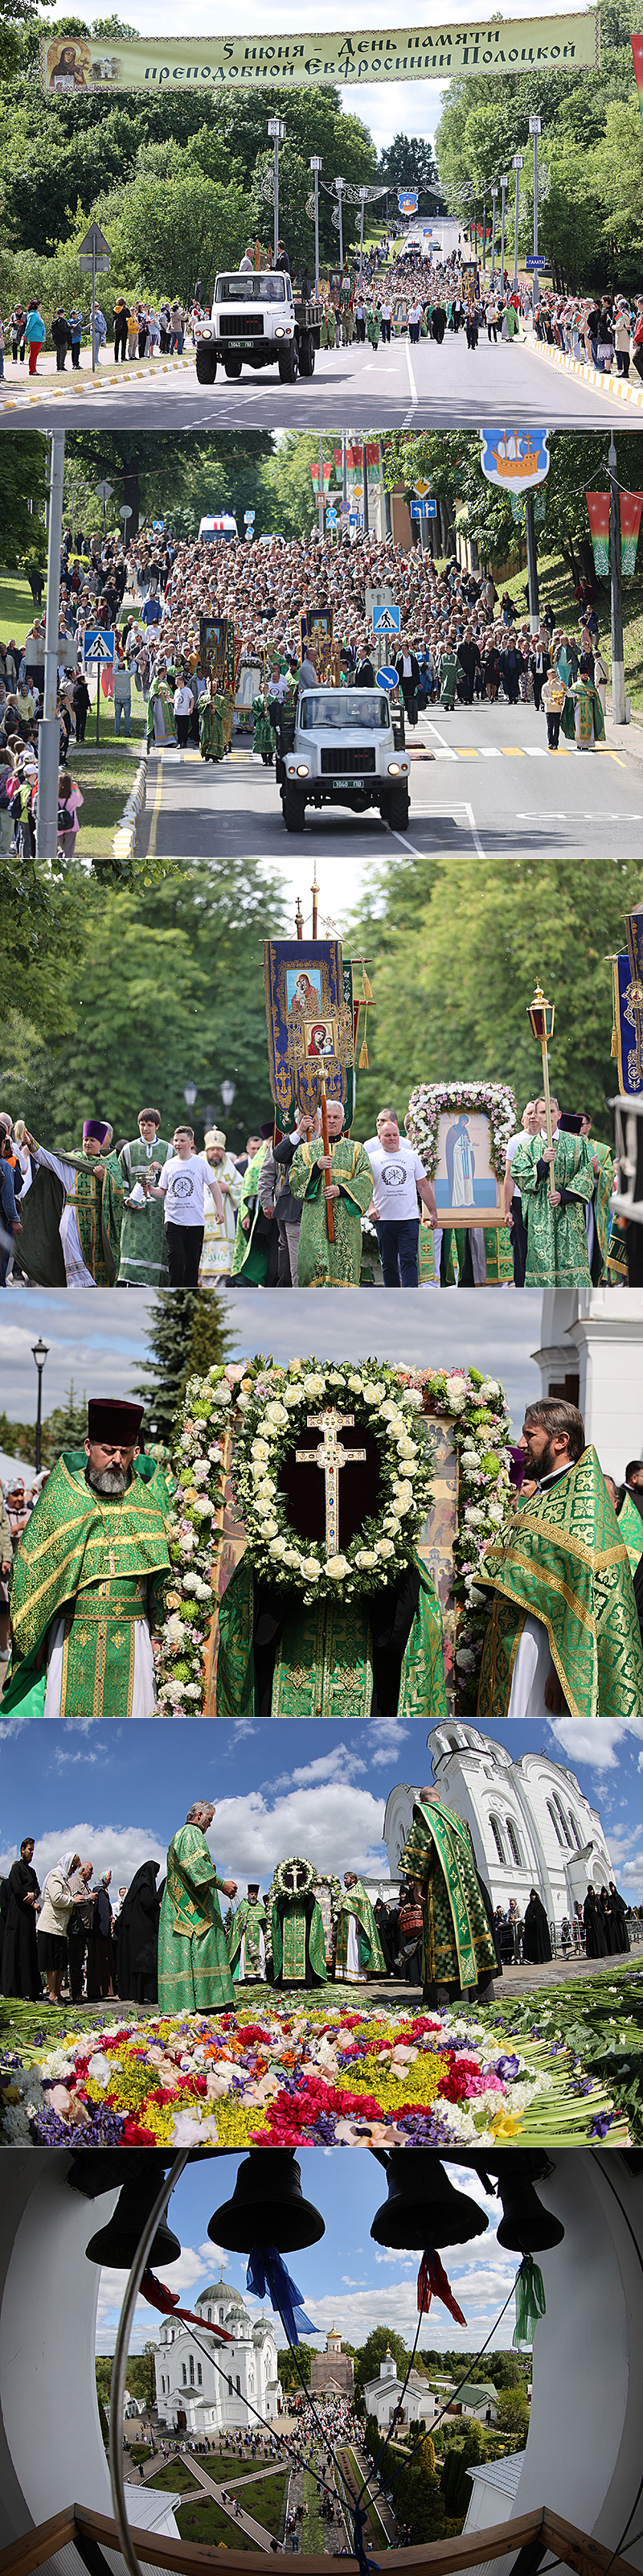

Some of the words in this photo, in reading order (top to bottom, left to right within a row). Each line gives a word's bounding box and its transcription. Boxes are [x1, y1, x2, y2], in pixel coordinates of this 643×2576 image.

[145, 61, 295, 84] преподобной
[305, 54, 452, 78] Евфросинии
[461, 41, 576, 65] Полоцкой
[223, 43, 235, 60] 5
[244, 45, 305, 60] июня
[338, 38, 397, 57] День
[408, 31, 500, 48] памяти
